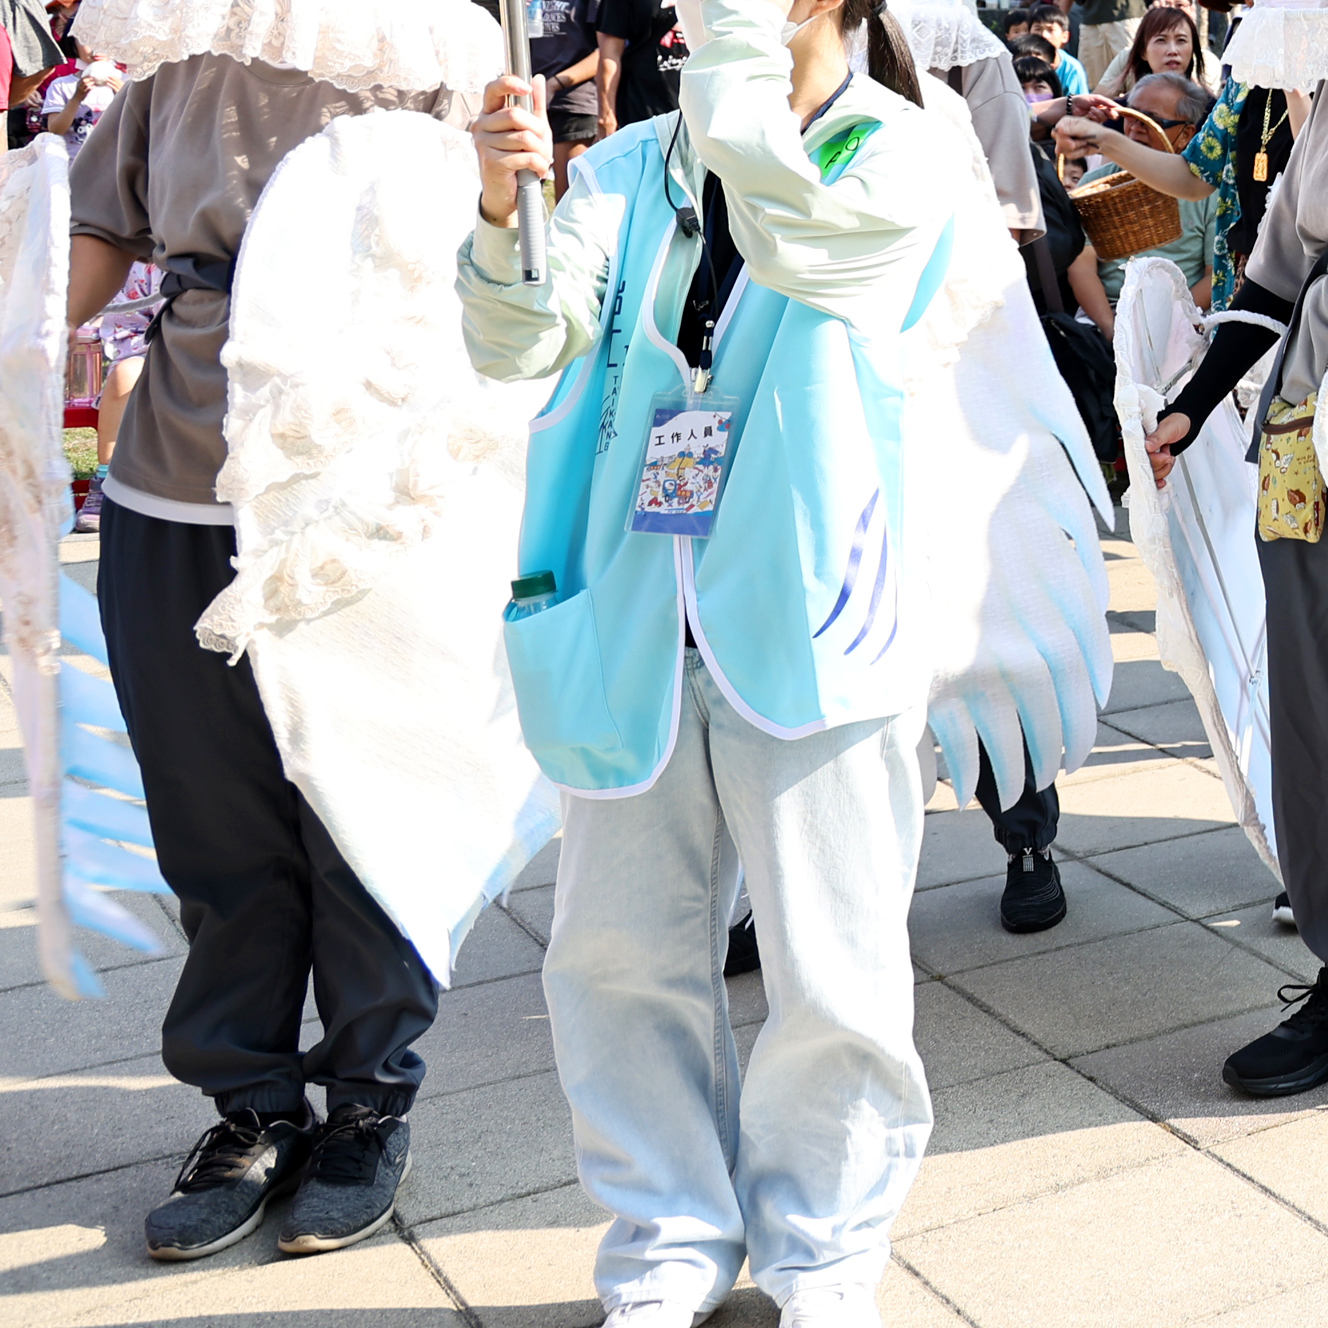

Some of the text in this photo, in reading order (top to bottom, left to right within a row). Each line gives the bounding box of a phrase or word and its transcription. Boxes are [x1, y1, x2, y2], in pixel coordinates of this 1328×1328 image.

[603, 375, 619, 452] TAIKANG
[654, 425, 714, 447] 工作人員
